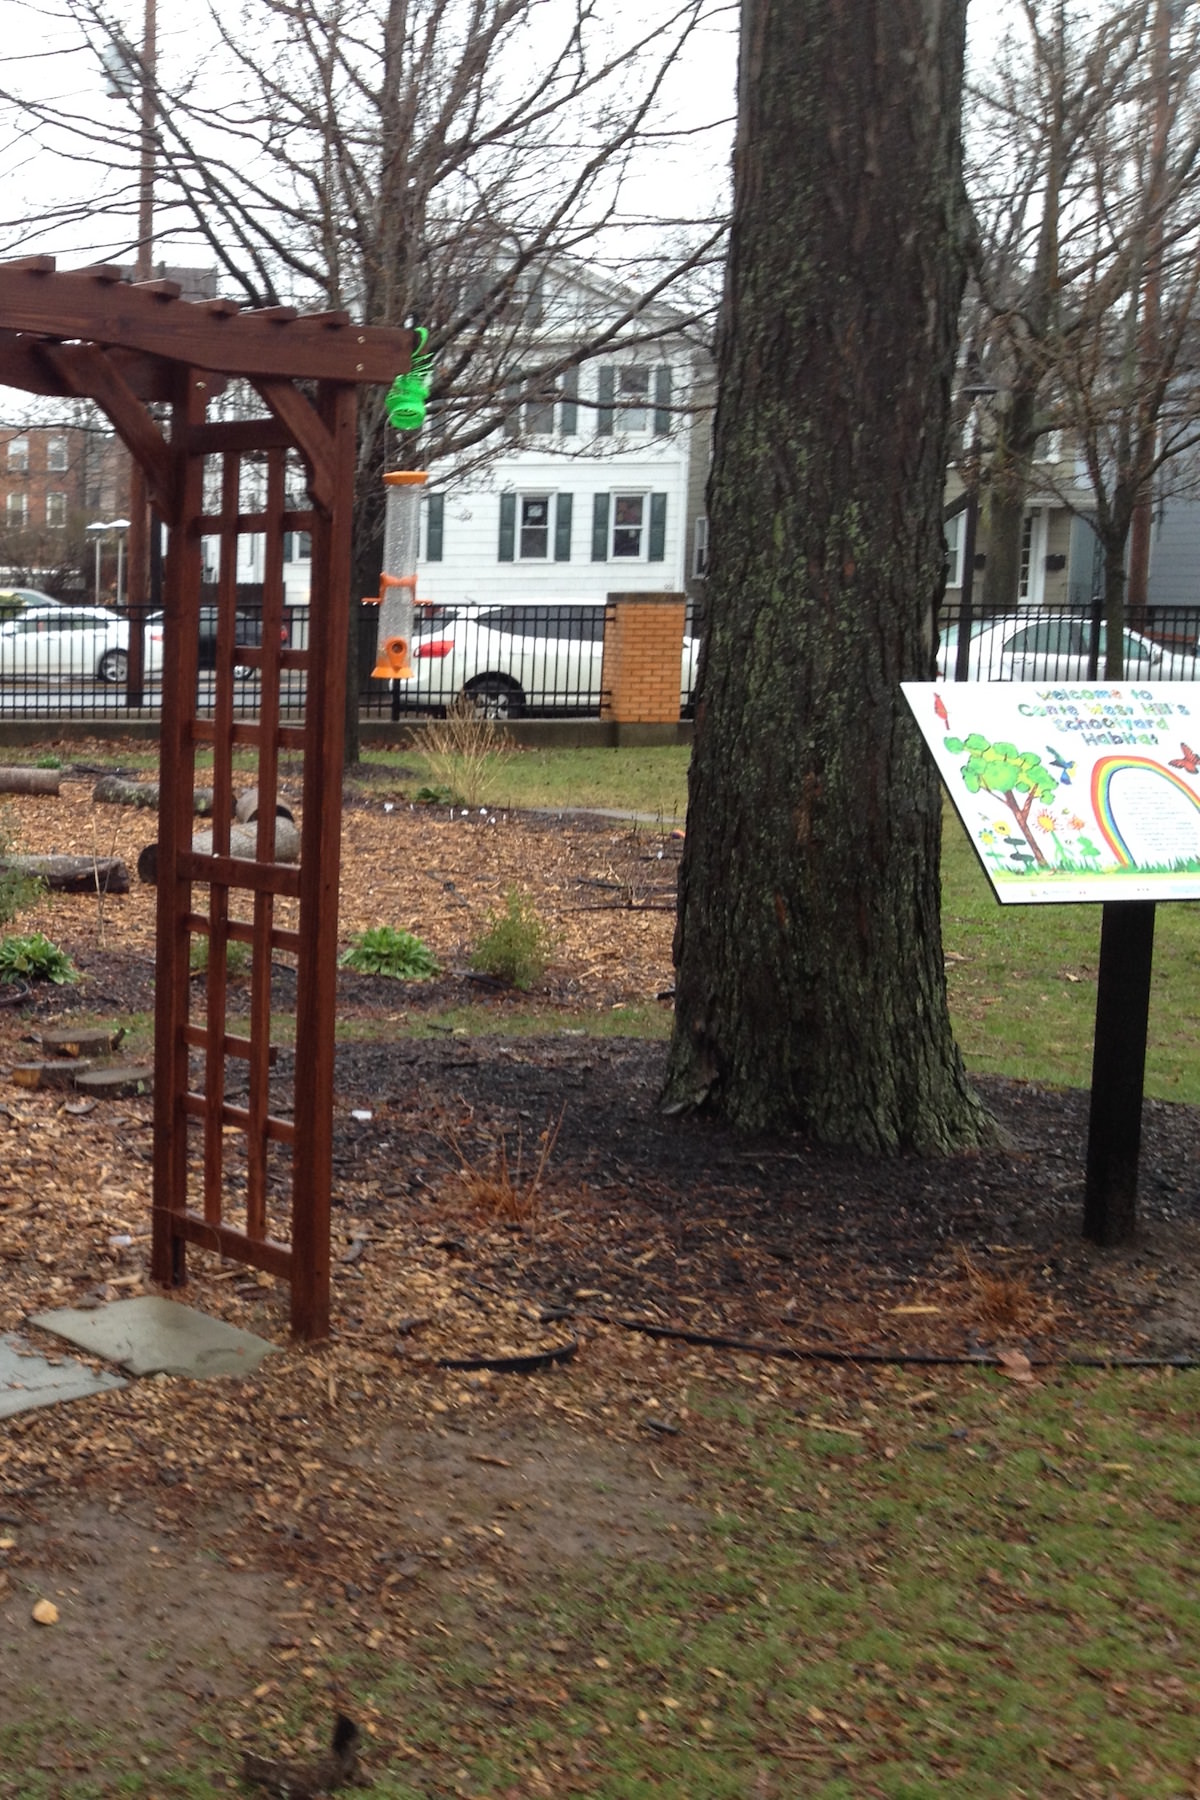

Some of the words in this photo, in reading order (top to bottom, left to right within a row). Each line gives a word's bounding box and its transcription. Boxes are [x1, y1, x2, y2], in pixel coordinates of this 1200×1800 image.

[1035, 689, 1122, 700] Welcome
[1131, 688, 1153, 700] to
[1084, 703, 1135, 716] West
[1054, 717, 1170, 732] Schoolyard
[1081, 732, 1158, 747] Habitat
